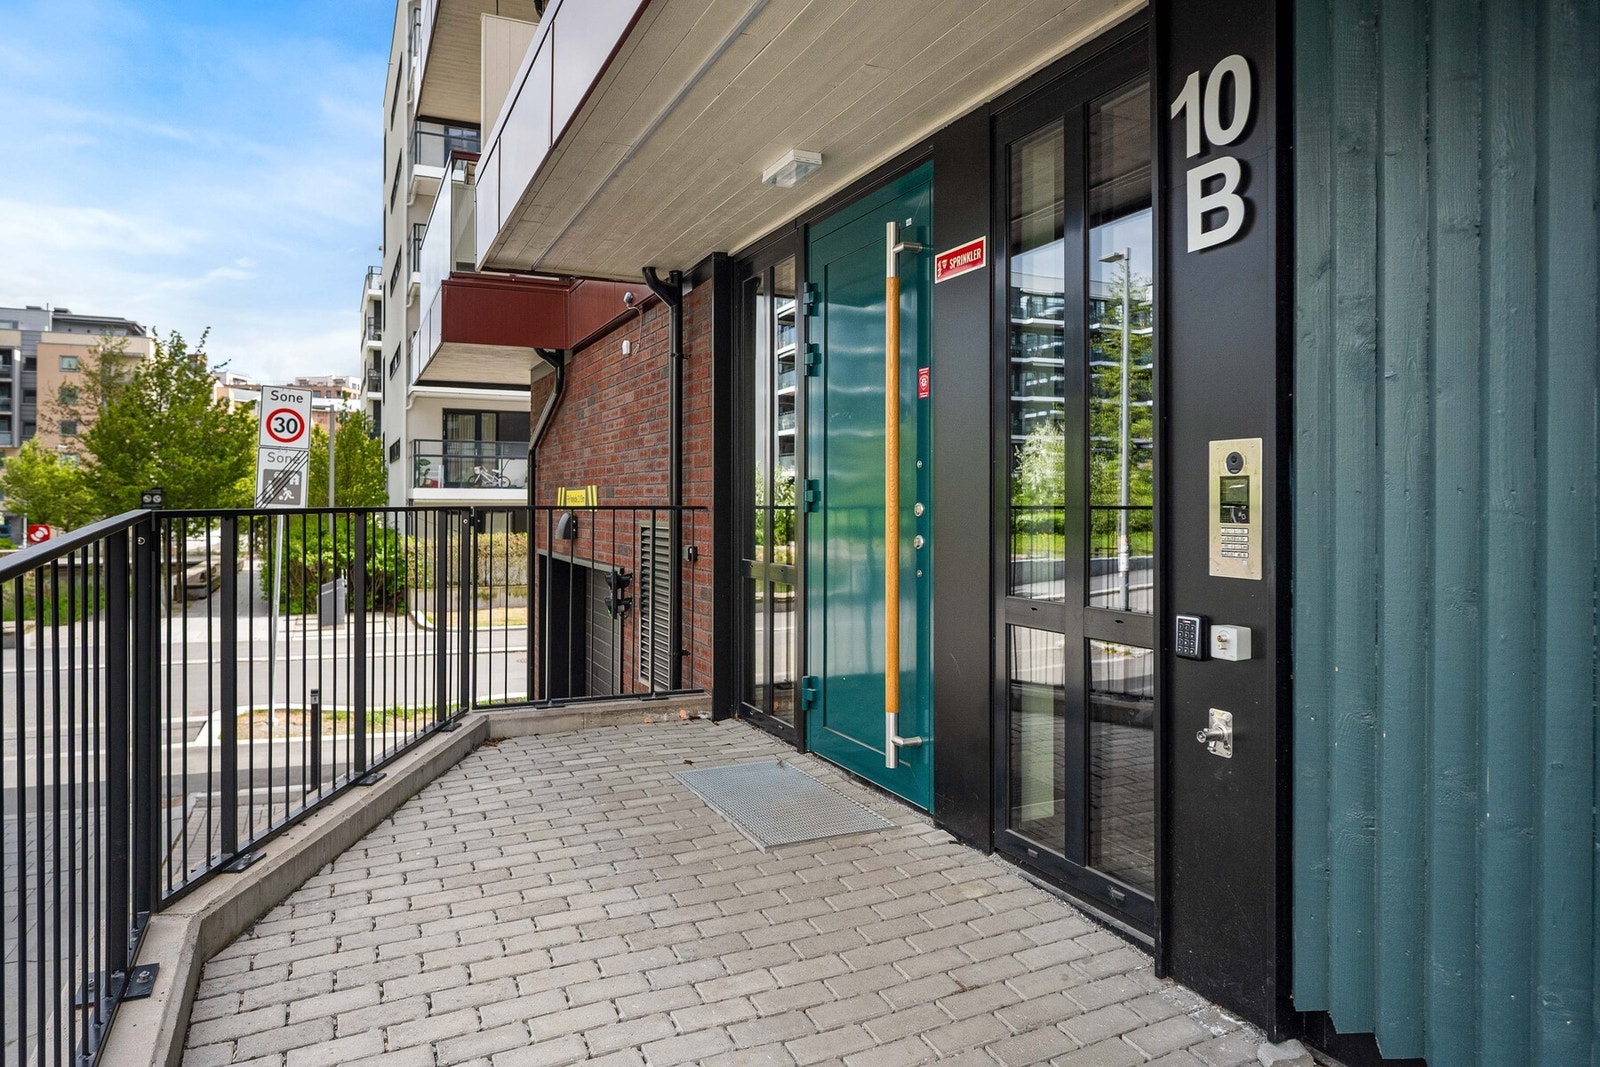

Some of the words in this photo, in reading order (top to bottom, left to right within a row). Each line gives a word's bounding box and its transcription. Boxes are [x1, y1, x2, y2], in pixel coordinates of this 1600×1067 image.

[1171, 54, 1251, 159] 10
[1186, 156, 1245, 253] B
[949, 248, 981, 270] SPRINKLER
[270, 390, 304, 403] Sone
[273, 417, 298, 434] 30
